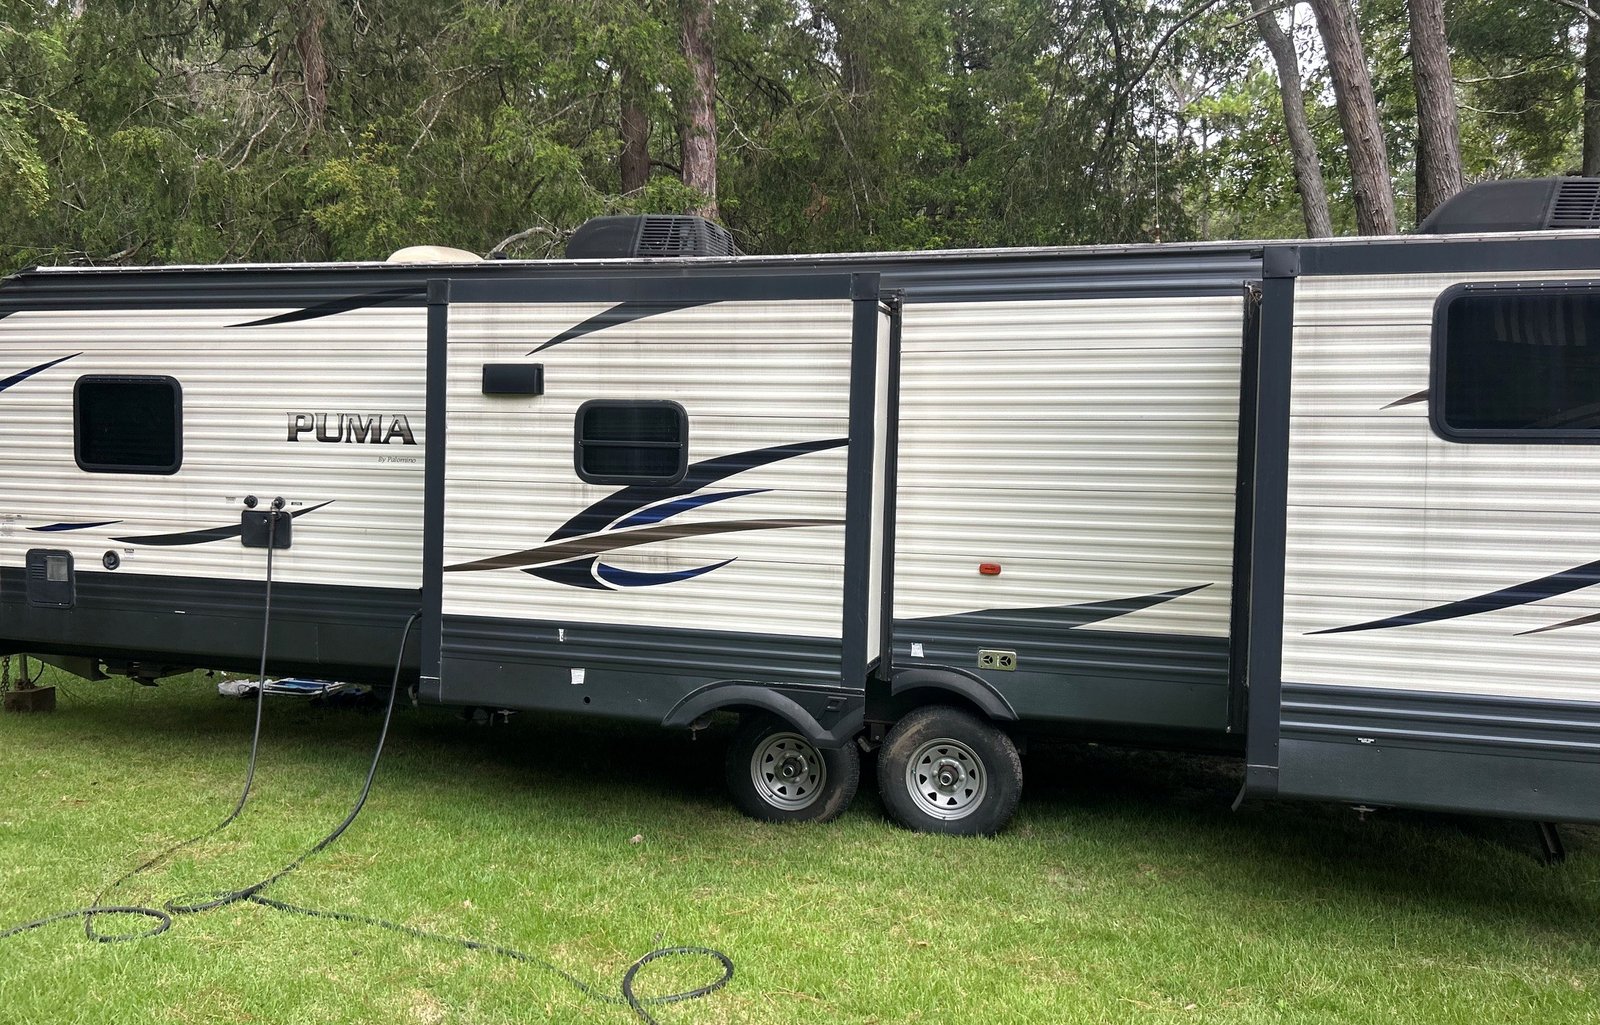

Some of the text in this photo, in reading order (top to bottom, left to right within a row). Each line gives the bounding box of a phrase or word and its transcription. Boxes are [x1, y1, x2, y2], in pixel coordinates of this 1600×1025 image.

[287, 412, 418, 445] PUMA
[378, 456, 417, 464] By Palomino
